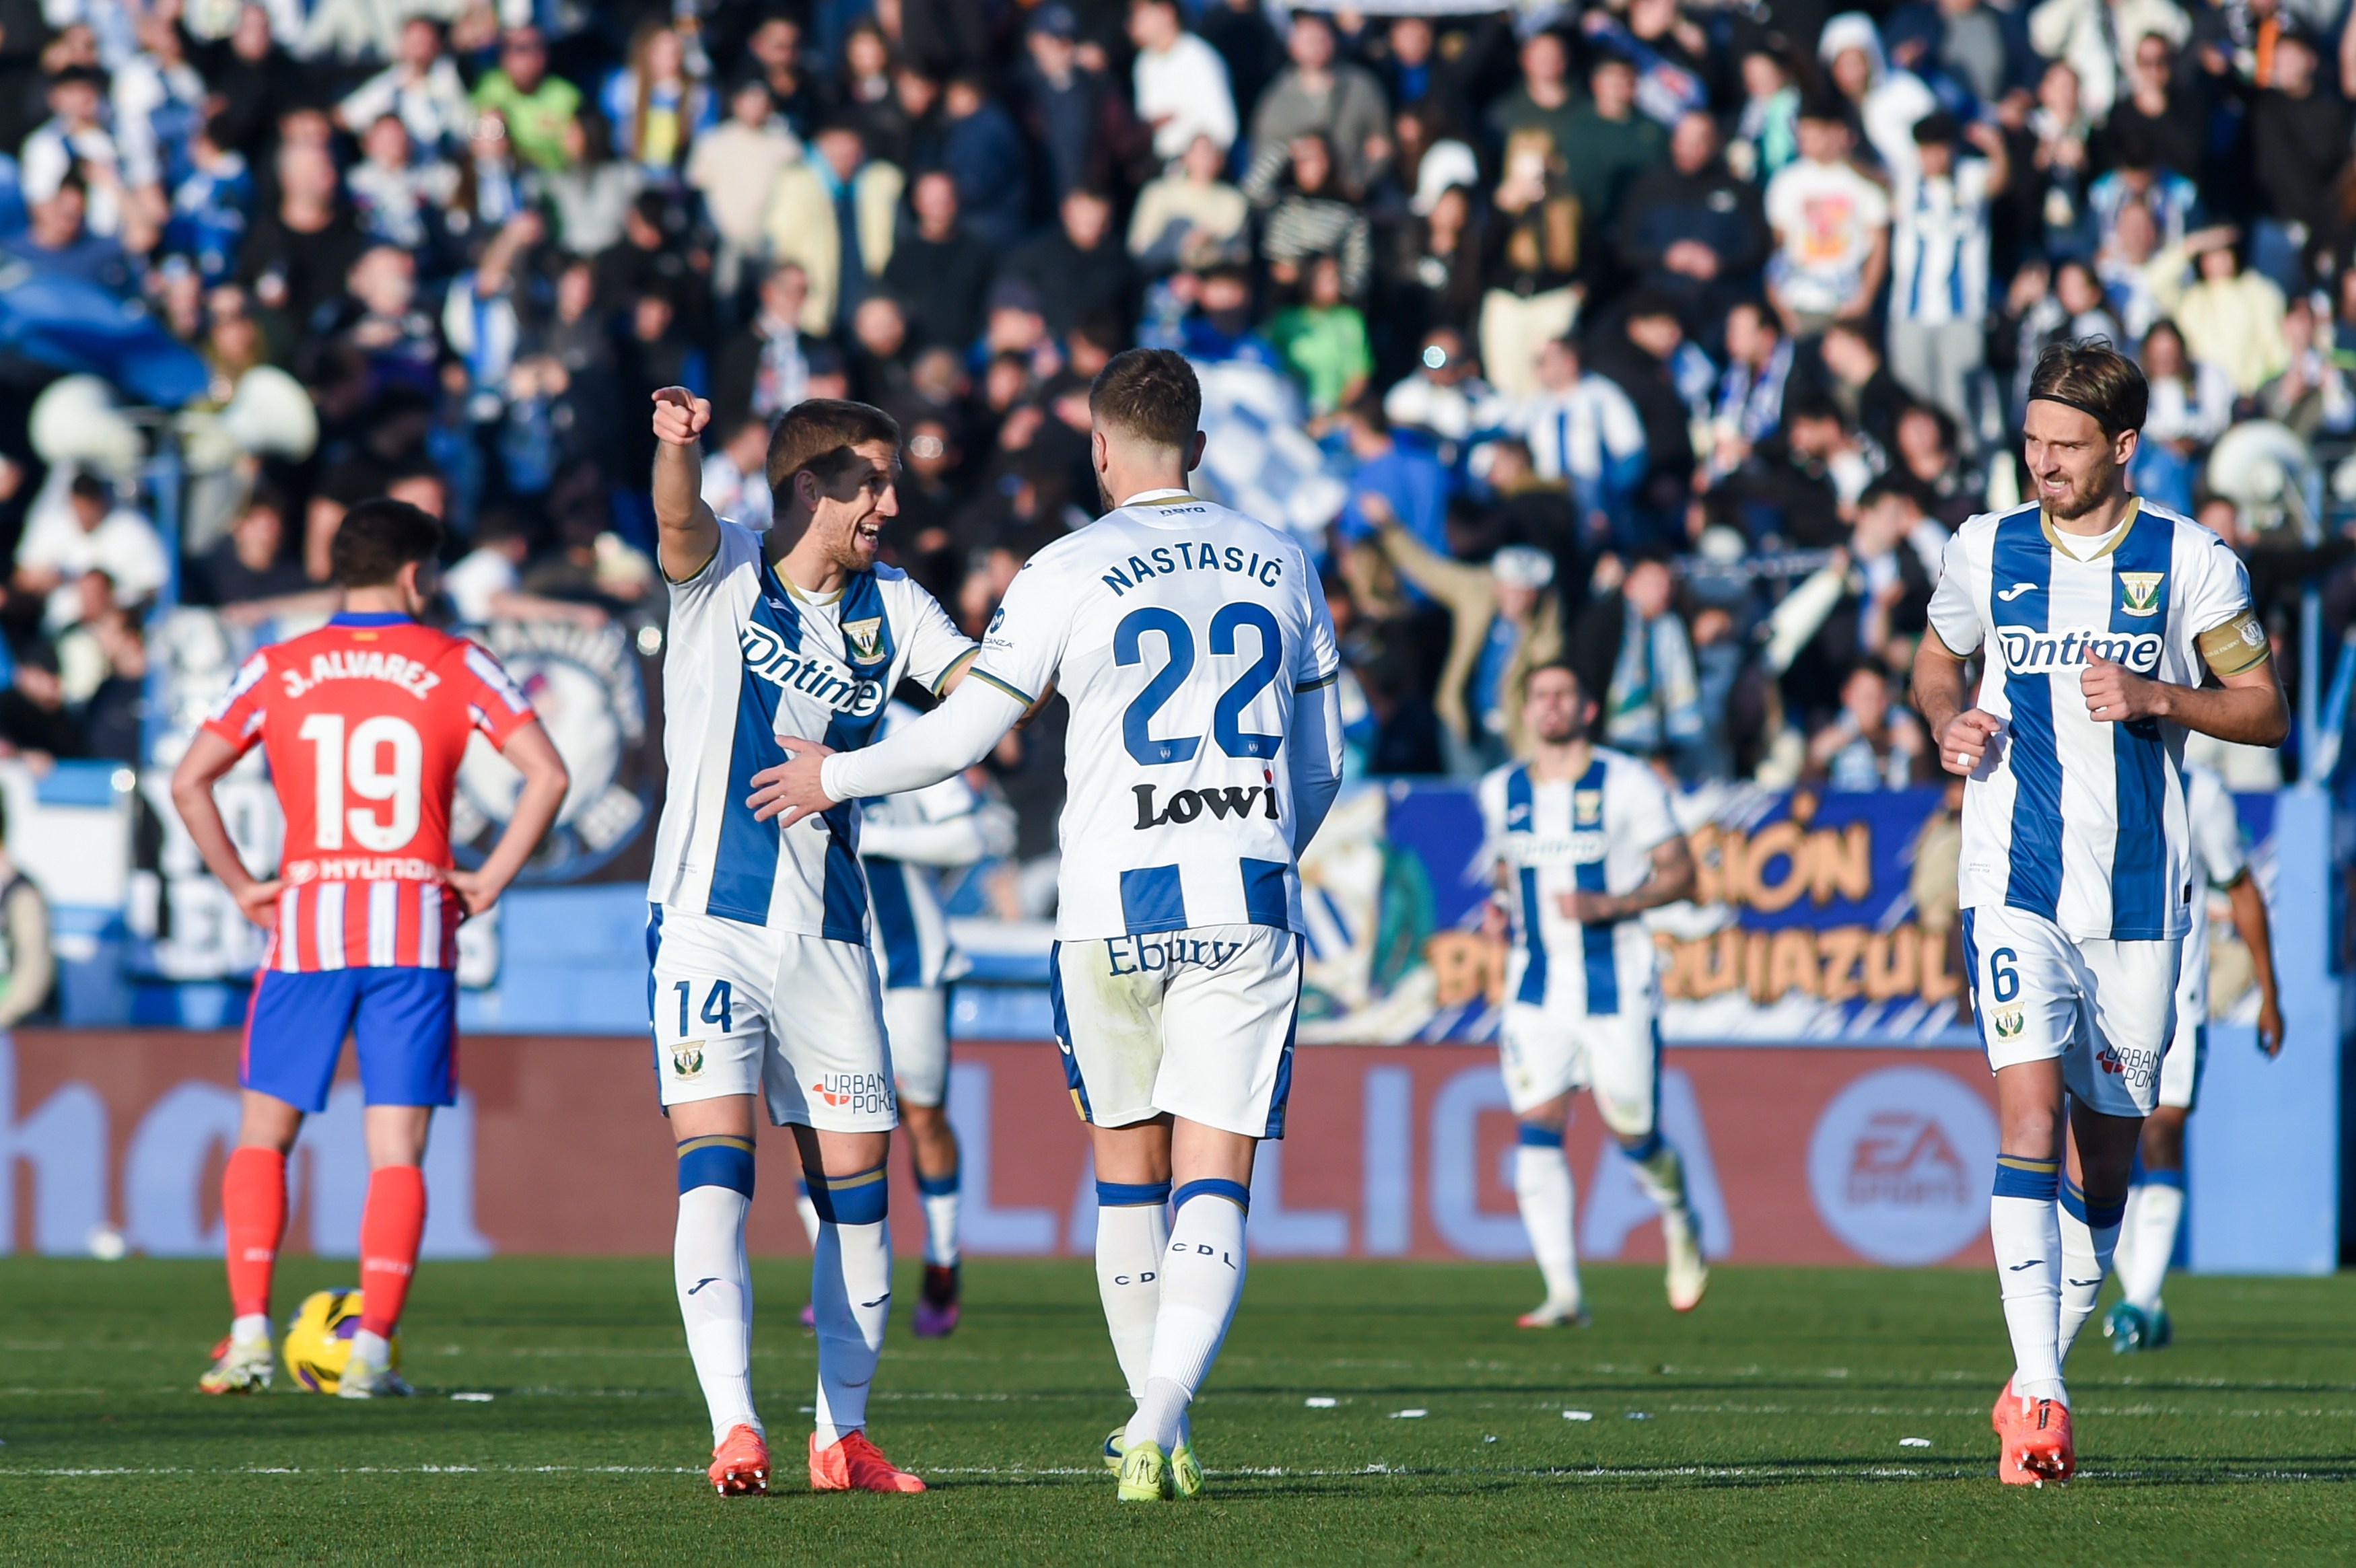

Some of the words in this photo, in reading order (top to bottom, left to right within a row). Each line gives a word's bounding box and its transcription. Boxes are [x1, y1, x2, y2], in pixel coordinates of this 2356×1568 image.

[1101, 542, 1284, 597] NASTASIĆ
[742, 625, 876, 711] Ontime
[2000, 630, 2158, 667] Ontime
[1113, 602, 1284, 767] 22
[298, 713, 423, 853] 19
[1132, 769, 1279, 830] Lowi
[1104, 933, 1242, 976] Ebury
[1990, 948, 2020, 1003] 6
[674, 979, 732, 1037] 14
[825, 1072, 887, 1095] URBAN
[944, 1063, 1732, 1260] LLIGA
